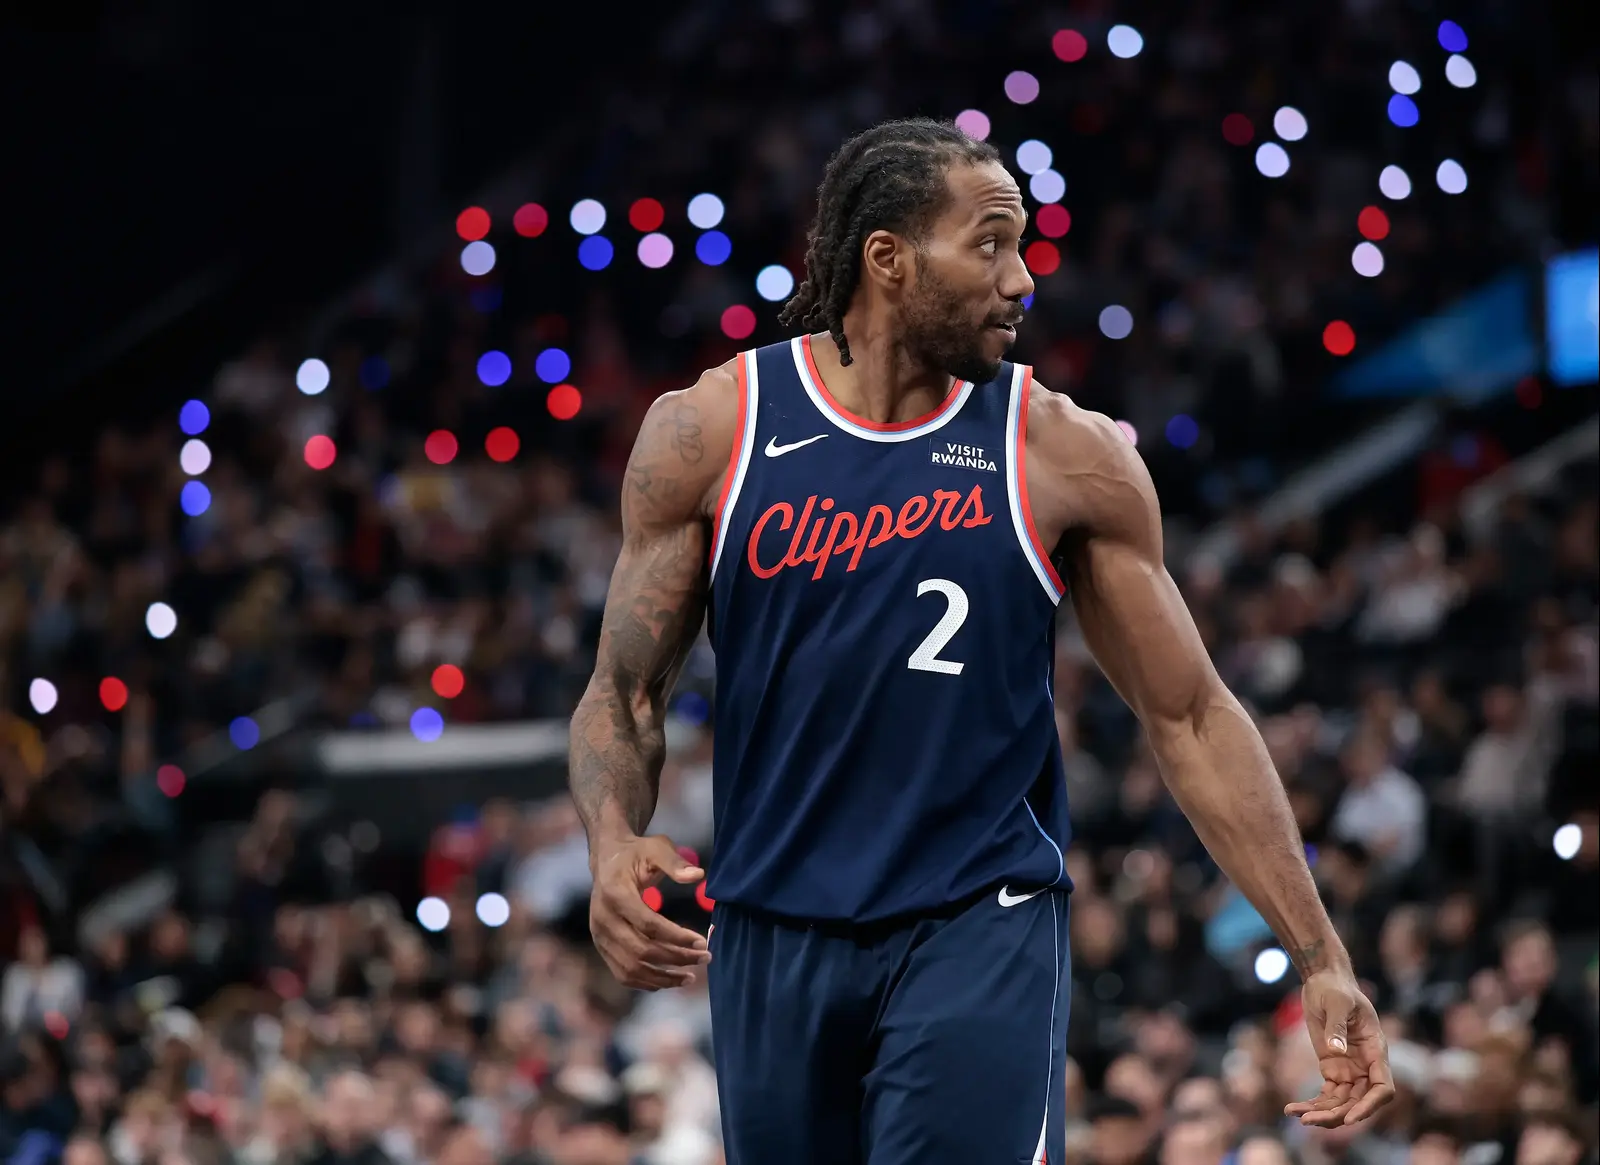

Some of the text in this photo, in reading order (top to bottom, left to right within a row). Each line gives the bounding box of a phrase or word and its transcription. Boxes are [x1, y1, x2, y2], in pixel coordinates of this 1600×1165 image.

[931, 452, 997, 472] RWANDA
[946, 442, 984, 458] VISIT
[748, 484, 993, 581] Clippers
[908, 579, 969, 675] 2
